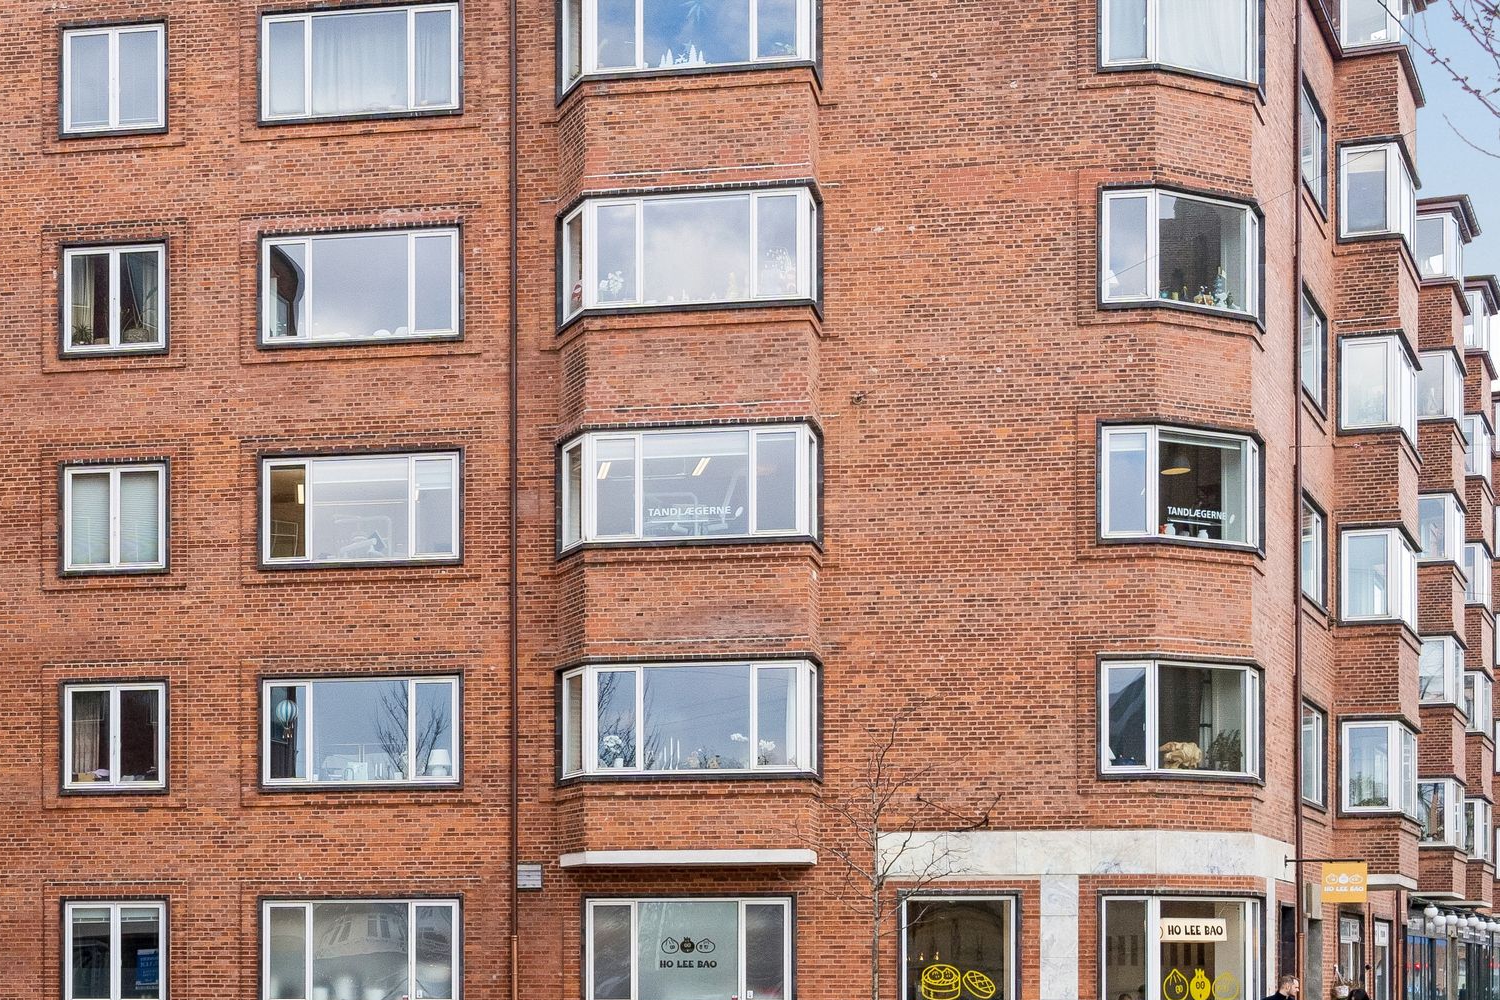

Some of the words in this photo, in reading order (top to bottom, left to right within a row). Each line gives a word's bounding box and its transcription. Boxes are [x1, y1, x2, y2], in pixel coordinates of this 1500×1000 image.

[648, 506, 731, 517] TANDLÆGERNE
[1167, 506, 1227, 520] TANDLÆGERNE
[1168, 925, 1182, 935] HO
[1184, 925, 1201, 935] LEE
[1204, 925, 1223, 935] BAO
[660, 960, 673, 968] HO
[677, 960, 694, 968] LEE
[697, 960, 717, 968] BAO
